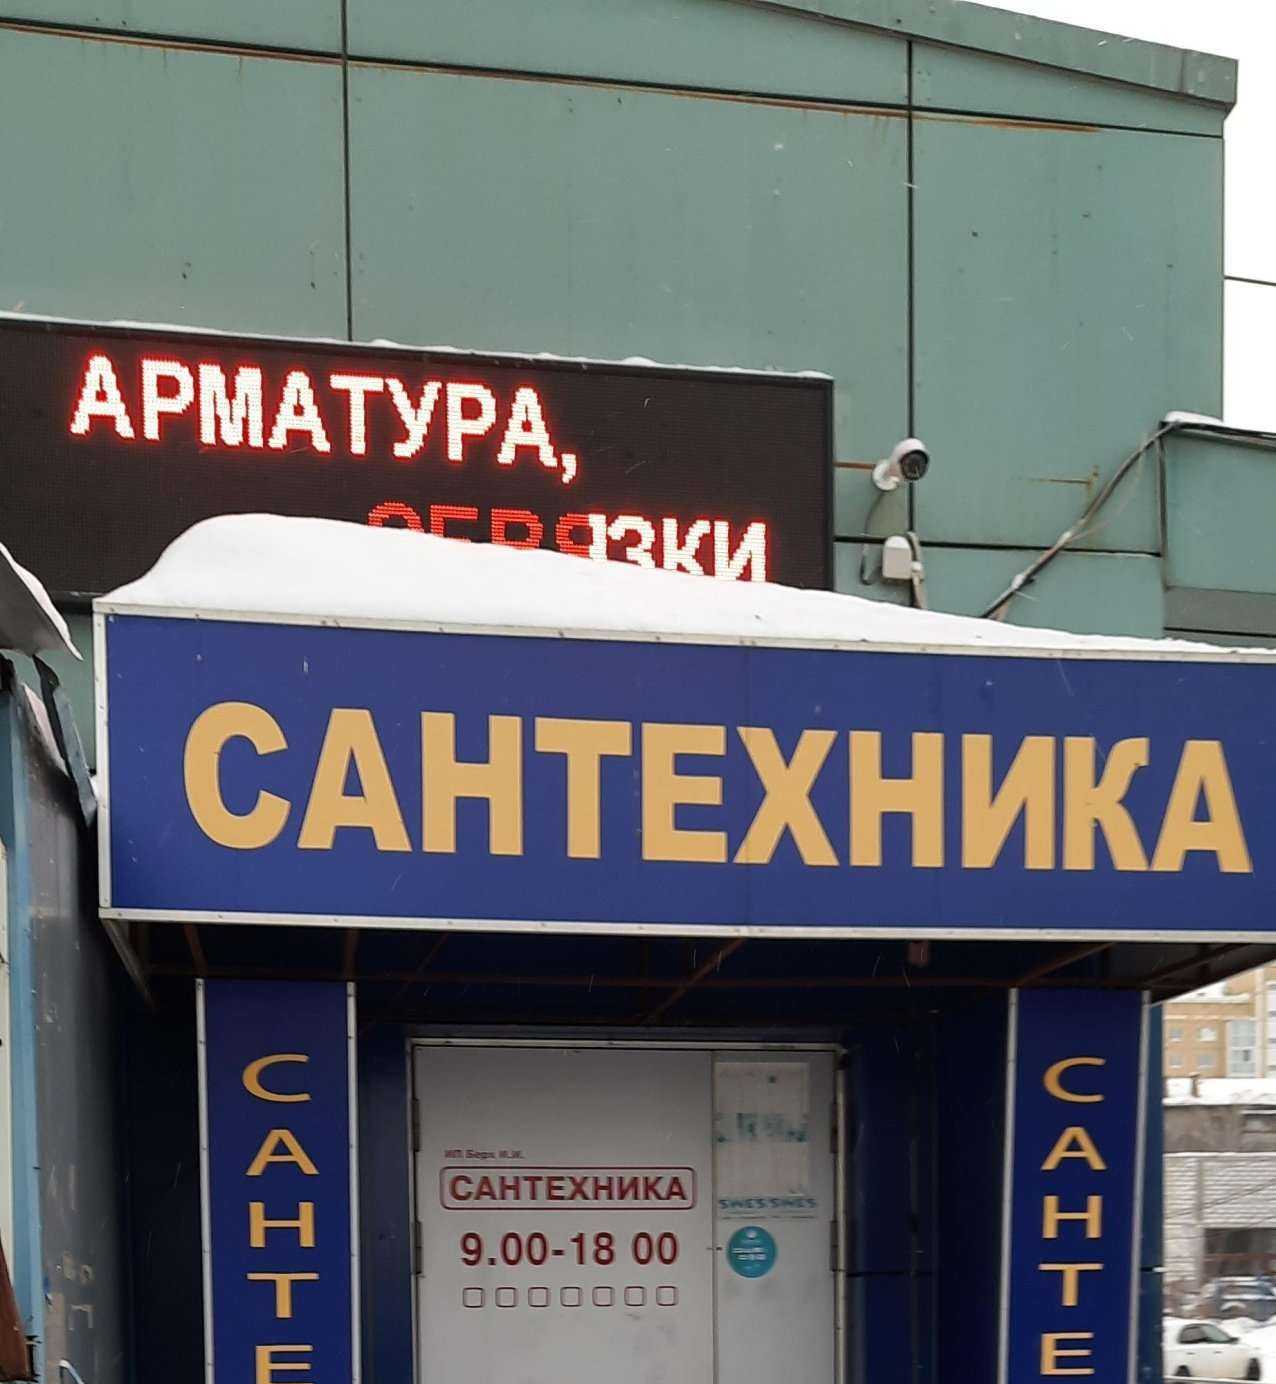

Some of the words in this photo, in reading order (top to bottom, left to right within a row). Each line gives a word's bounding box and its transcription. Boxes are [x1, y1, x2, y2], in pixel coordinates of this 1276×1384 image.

[69, 353, 579, 484] АРМАТУРА,
[183, 701, 1253, 874] САНТЕХНИКА
[448, 1174, 688, 1202] САНТЕХНИКА
[460, 1231, 616, 1267] 9.00-18
[632, 1231, 679, 1265] 00
